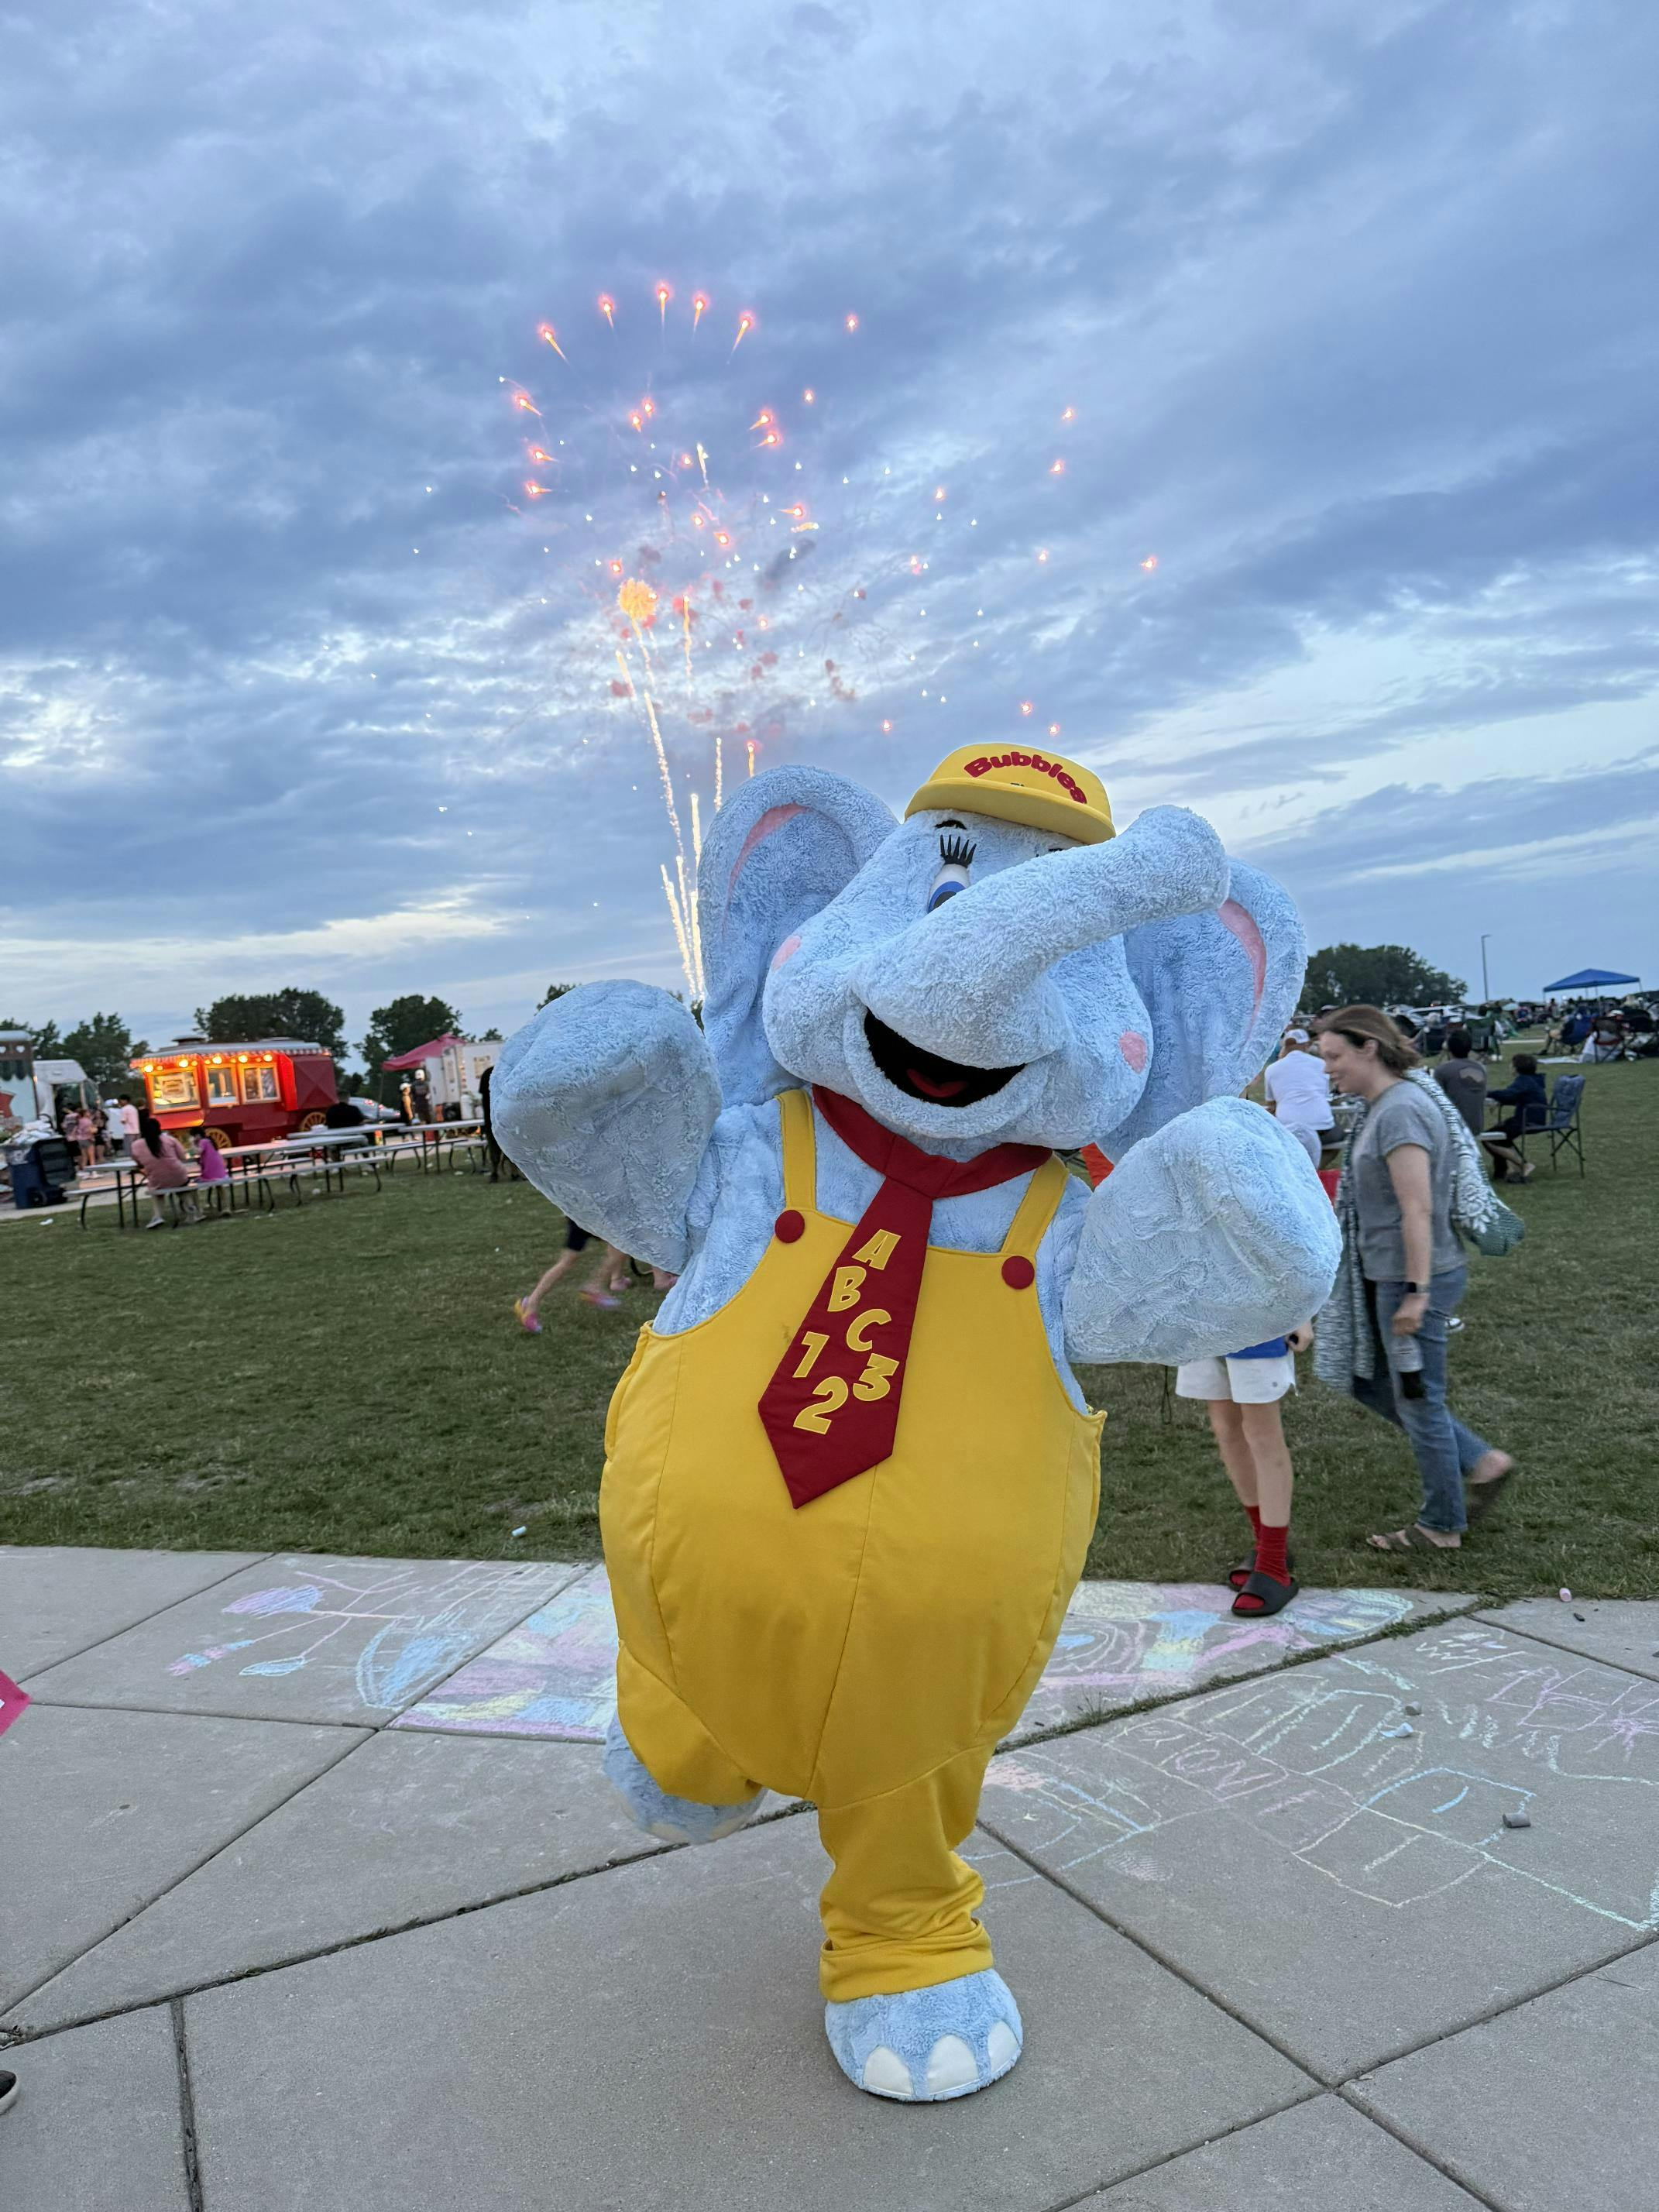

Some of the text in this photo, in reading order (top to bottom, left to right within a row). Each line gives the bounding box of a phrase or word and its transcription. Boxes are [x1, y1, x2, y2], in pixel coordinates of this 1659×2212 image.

[963, 751, 1087, 805] Bubbles
[827, 1229, 902, 1352] A B C
[792, 1331, 900, 1435] 1 2 3
